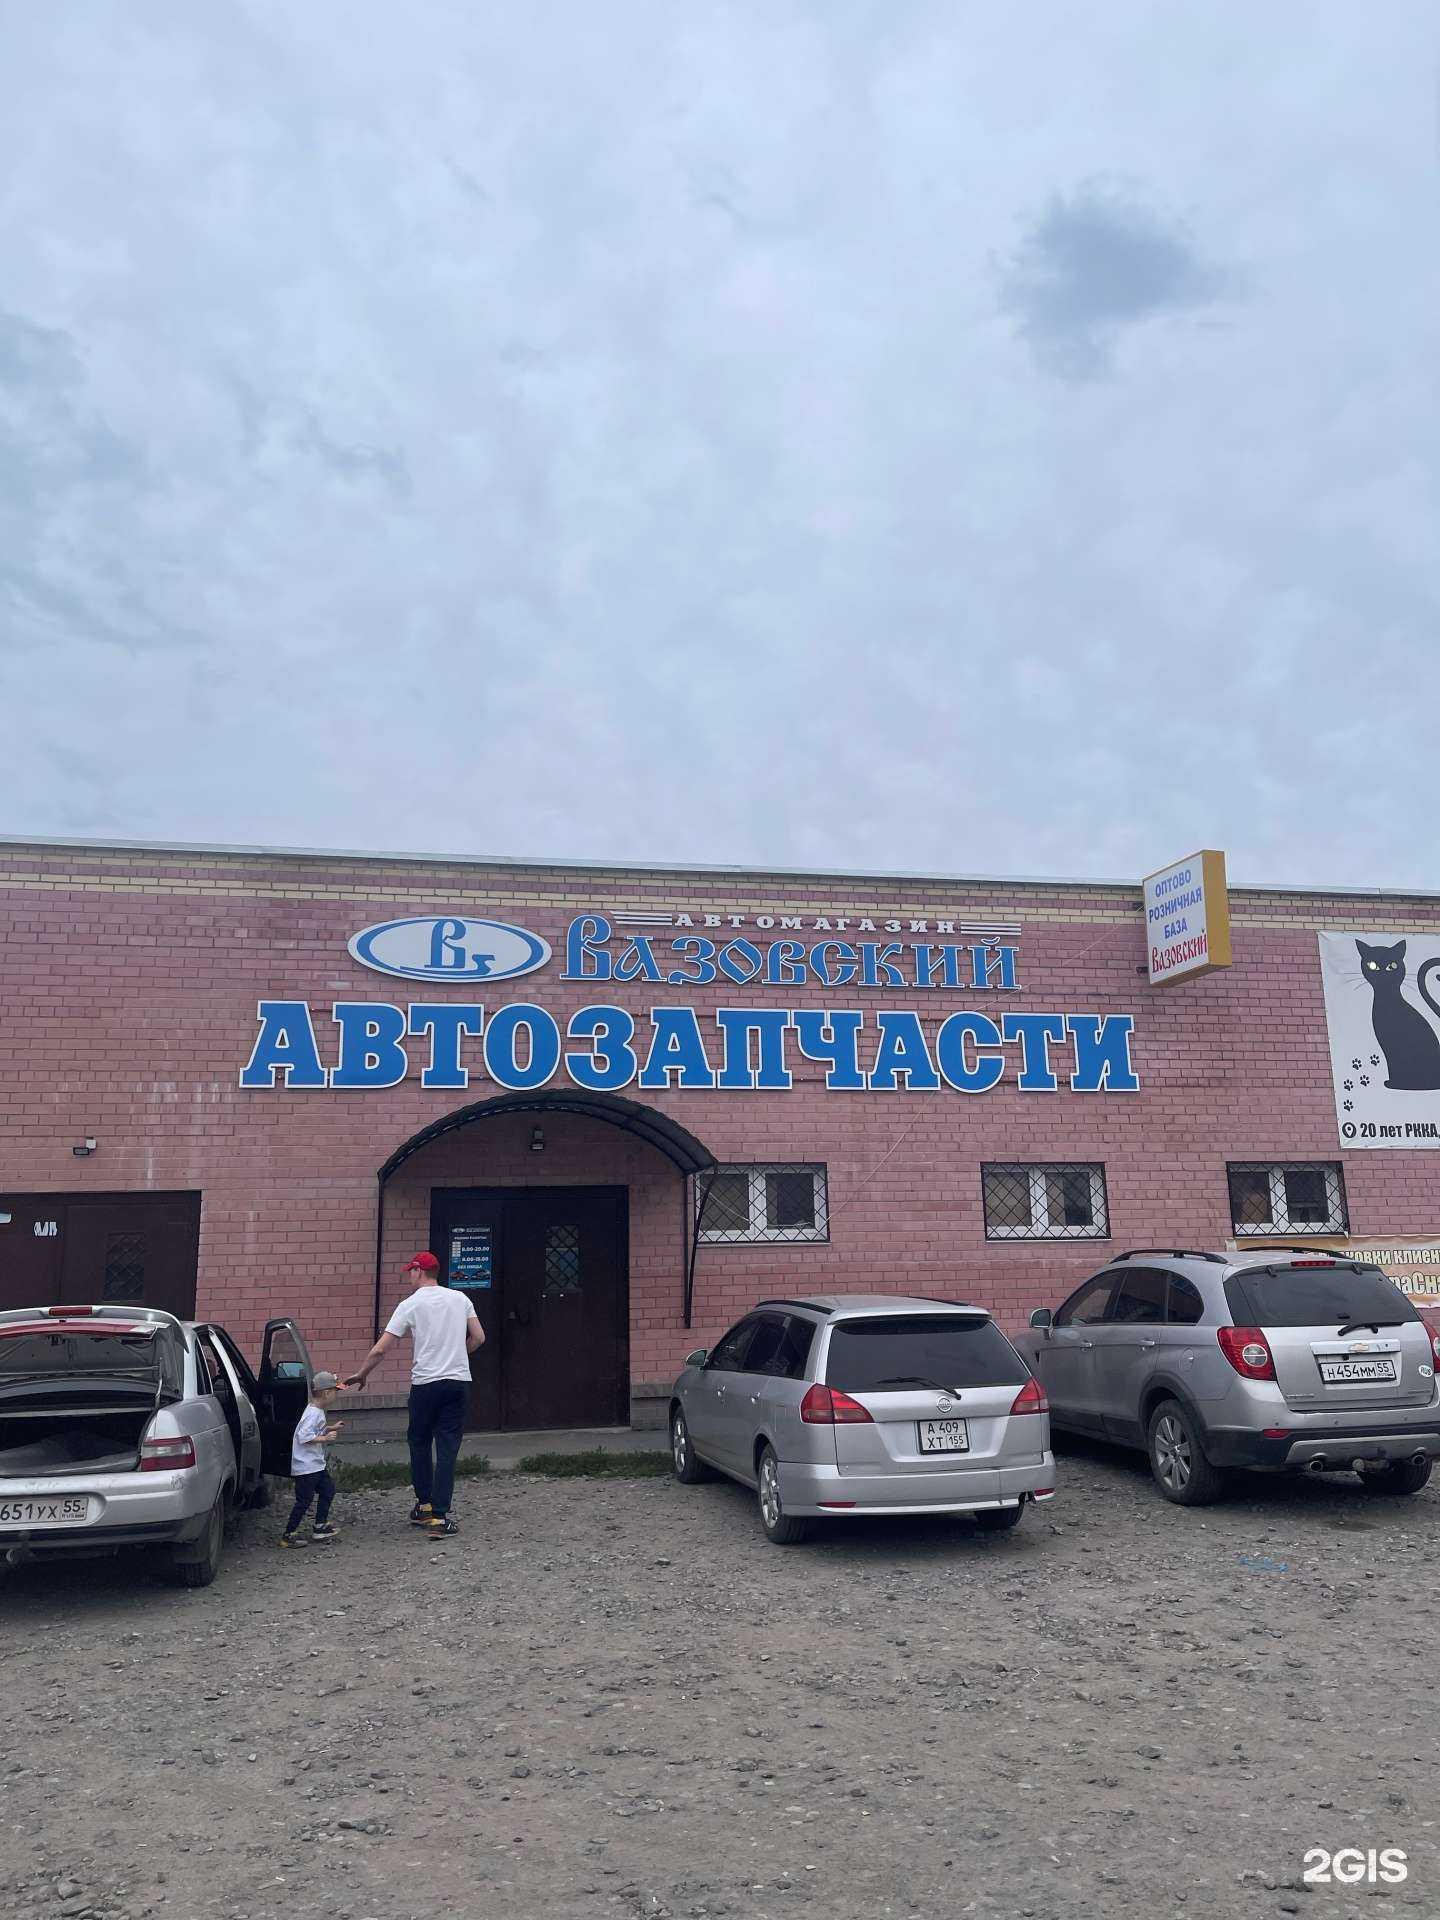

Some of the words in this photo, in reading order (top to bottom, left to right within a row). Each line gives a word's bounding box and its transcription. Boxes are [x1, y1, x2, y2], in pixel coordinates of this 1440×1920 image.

[1155, 870, 1191, 897] ОПТОВО
[1149, 887, 1202, 923] РОЗНИЧНАЯ
[675, 913, 956, 933] АВТОМАГАЗИН
[1164, 918, 1188, 939] БАЗА
[238, 1000, 1140, 1093] АВТОЗАПЧАСТИ
[1360, 1123, 1376, 1138] 20
[1380, 1125, 1402, 1138] лет
[1394, 1248, 1440, 1265] клиен
[939, 1422, 959, 1433] 409
[949, 1436, 964, 1445] 155
[63, 1500, 81, 1513] 55
